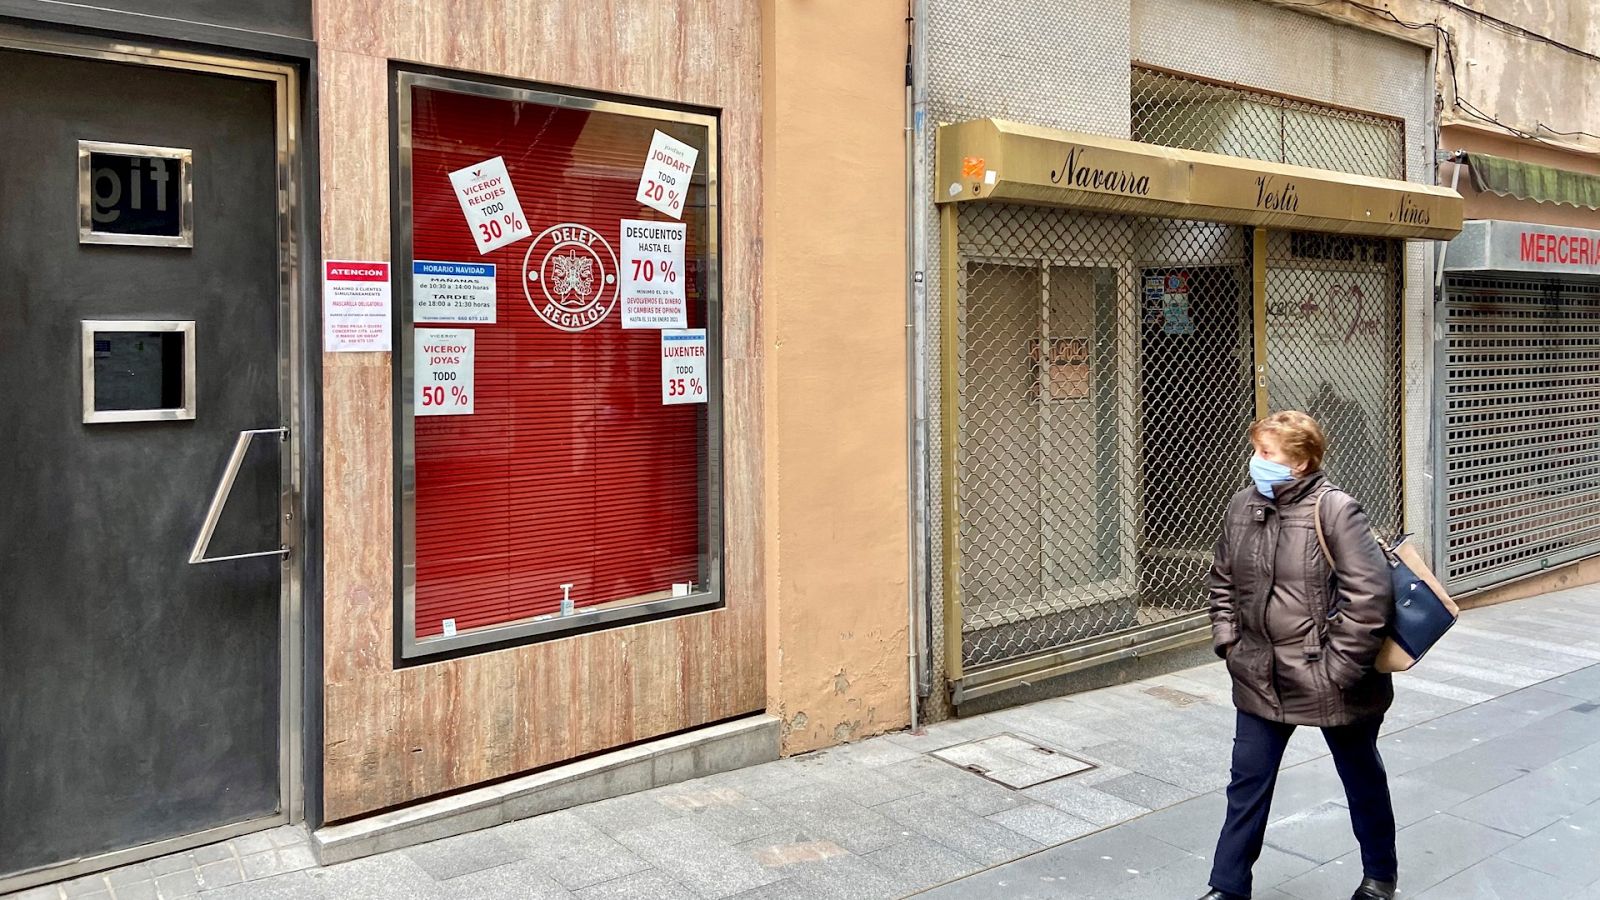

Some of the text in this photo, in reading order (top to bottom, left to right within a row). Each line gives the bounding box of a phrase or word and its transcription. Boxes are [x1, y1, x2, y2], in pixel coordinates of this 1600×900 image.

[651, 149, 691, 174] JOIDART
[1050, 146, 1150, 196] Navarra
[462, 176, 502, 196] VICEROY
[658, 171, 676, 186] TODO
[468, 187, 506, 206] RELOJES
[644, 180, 680, 210] 20 %
[1254, 175, 1300, 213] Vestir
[481, 201, 504, 217] TODO
[1389, 193, 1431, 226] Niños
[479, 212, 522, 243] 30 %
[551, 227, 598, 246] DELEY
[626, 227, 683, 241] DESCUENTOS
[638, 243, 672, 253] HASTA EL
[330, 268, 383, 276] ATENCIÓN
[423, 265, 485, 274] HORARIO NAVIDAD
[631, 259, 676, 283] 70 %
[542, 302, 606, 327] REGALOS
[424, 345, 467, 353] VICEROY
[664, 346, 705, 357] LUXENTER
[429, 356, 460, 365] JOYAS
[676, 365, 694, 374] TODO
[433, 371, 457, 381] TODO
[422, 385, 468, 406] 50 %
[669, 377, 703, 396] 35 %
